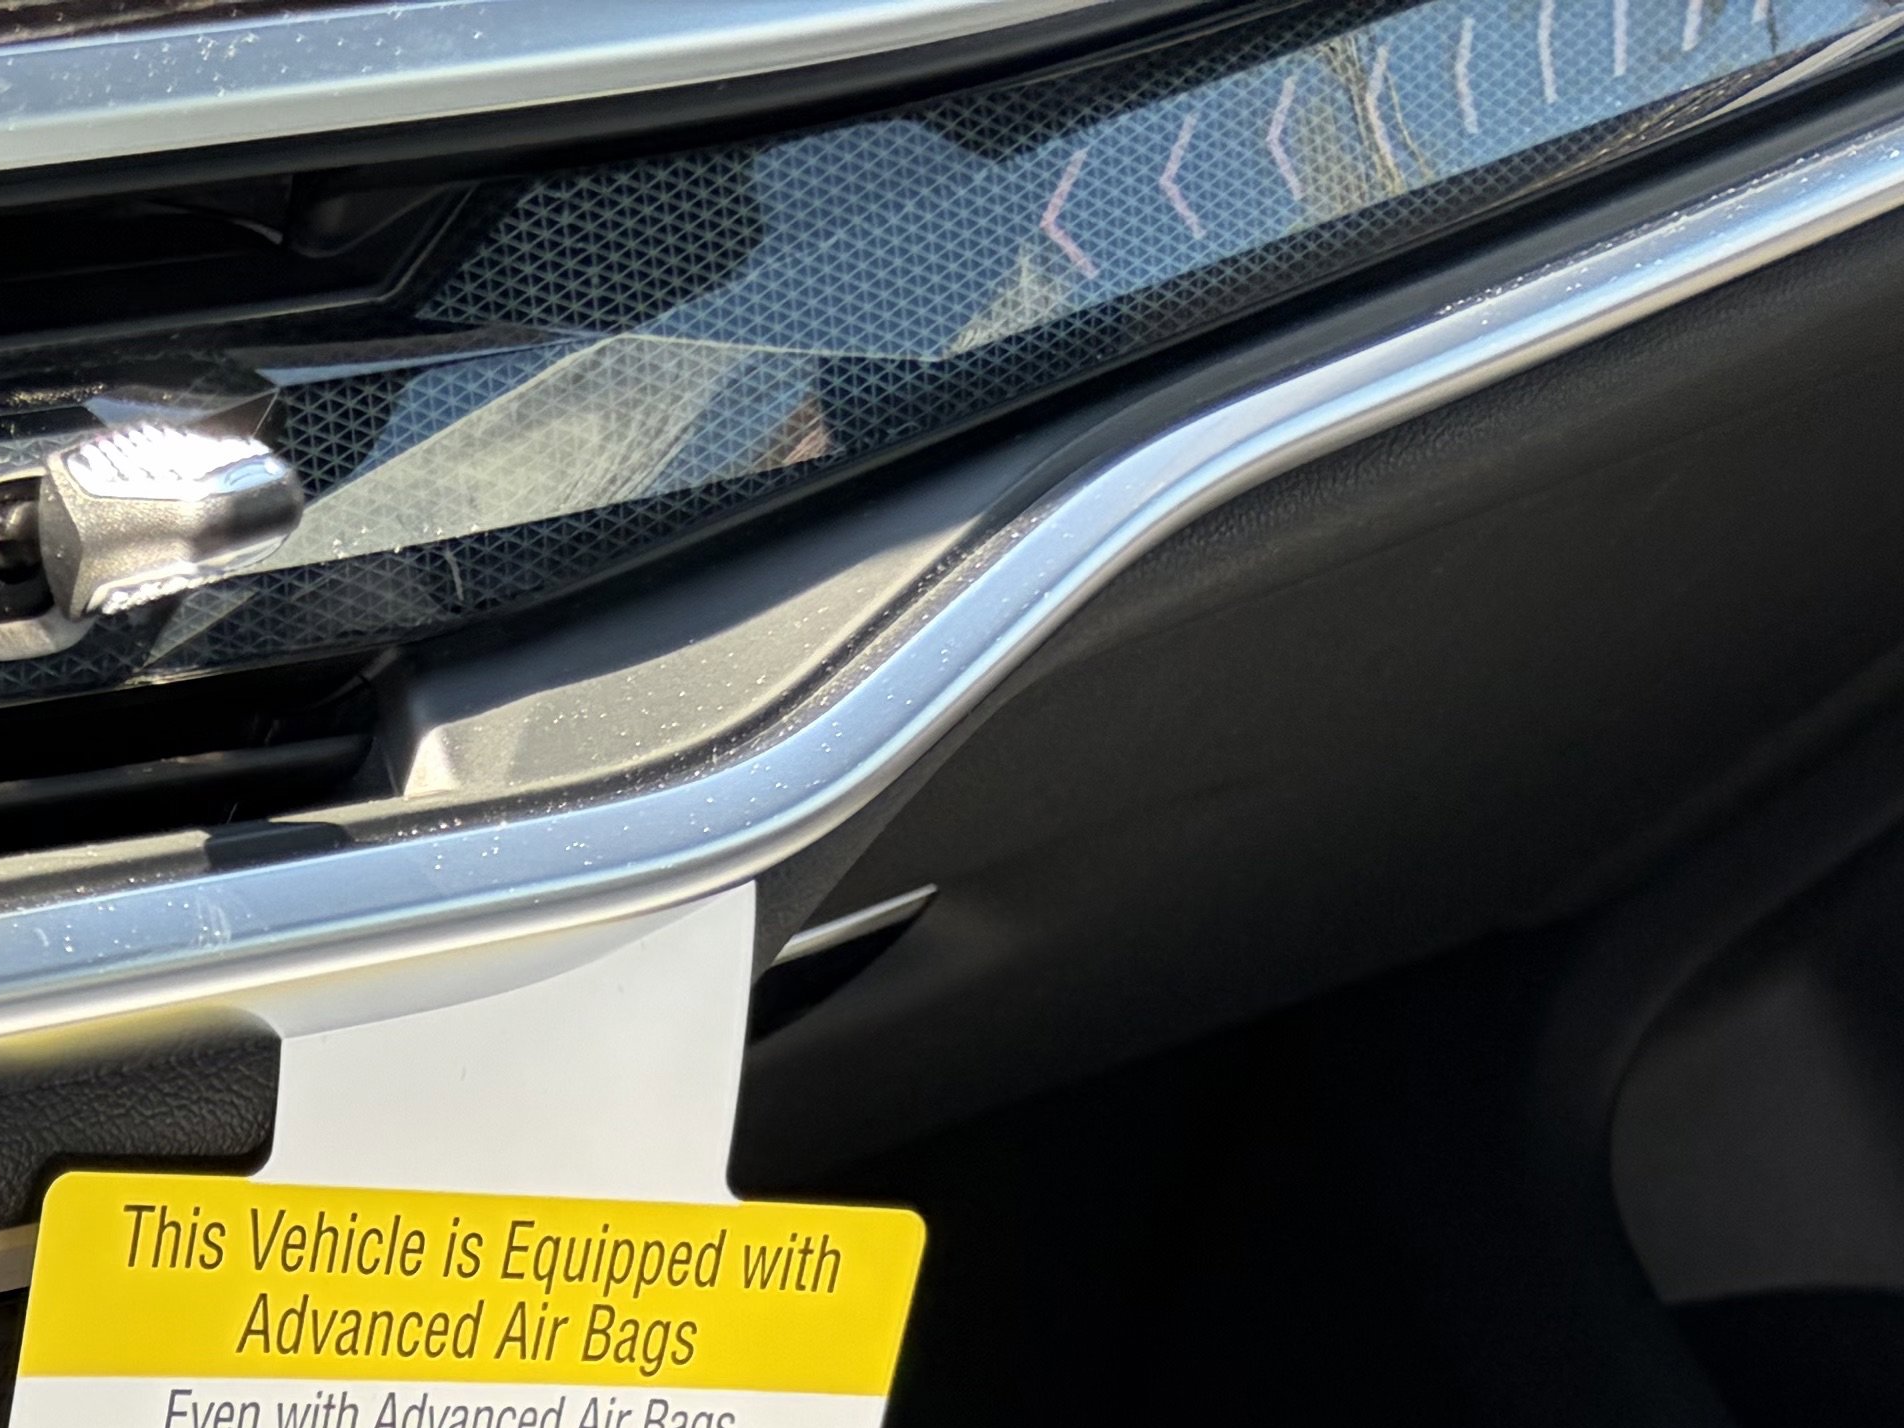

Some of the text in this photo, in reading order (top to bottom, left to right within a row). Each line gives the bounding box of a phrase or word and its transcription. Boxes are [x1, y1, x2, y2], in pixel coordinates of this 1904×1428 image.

[122, 1203, 843, 1300] This Vehicle is Equipped with
[234, 1291, 699, 1379] Advanced Air Bags
